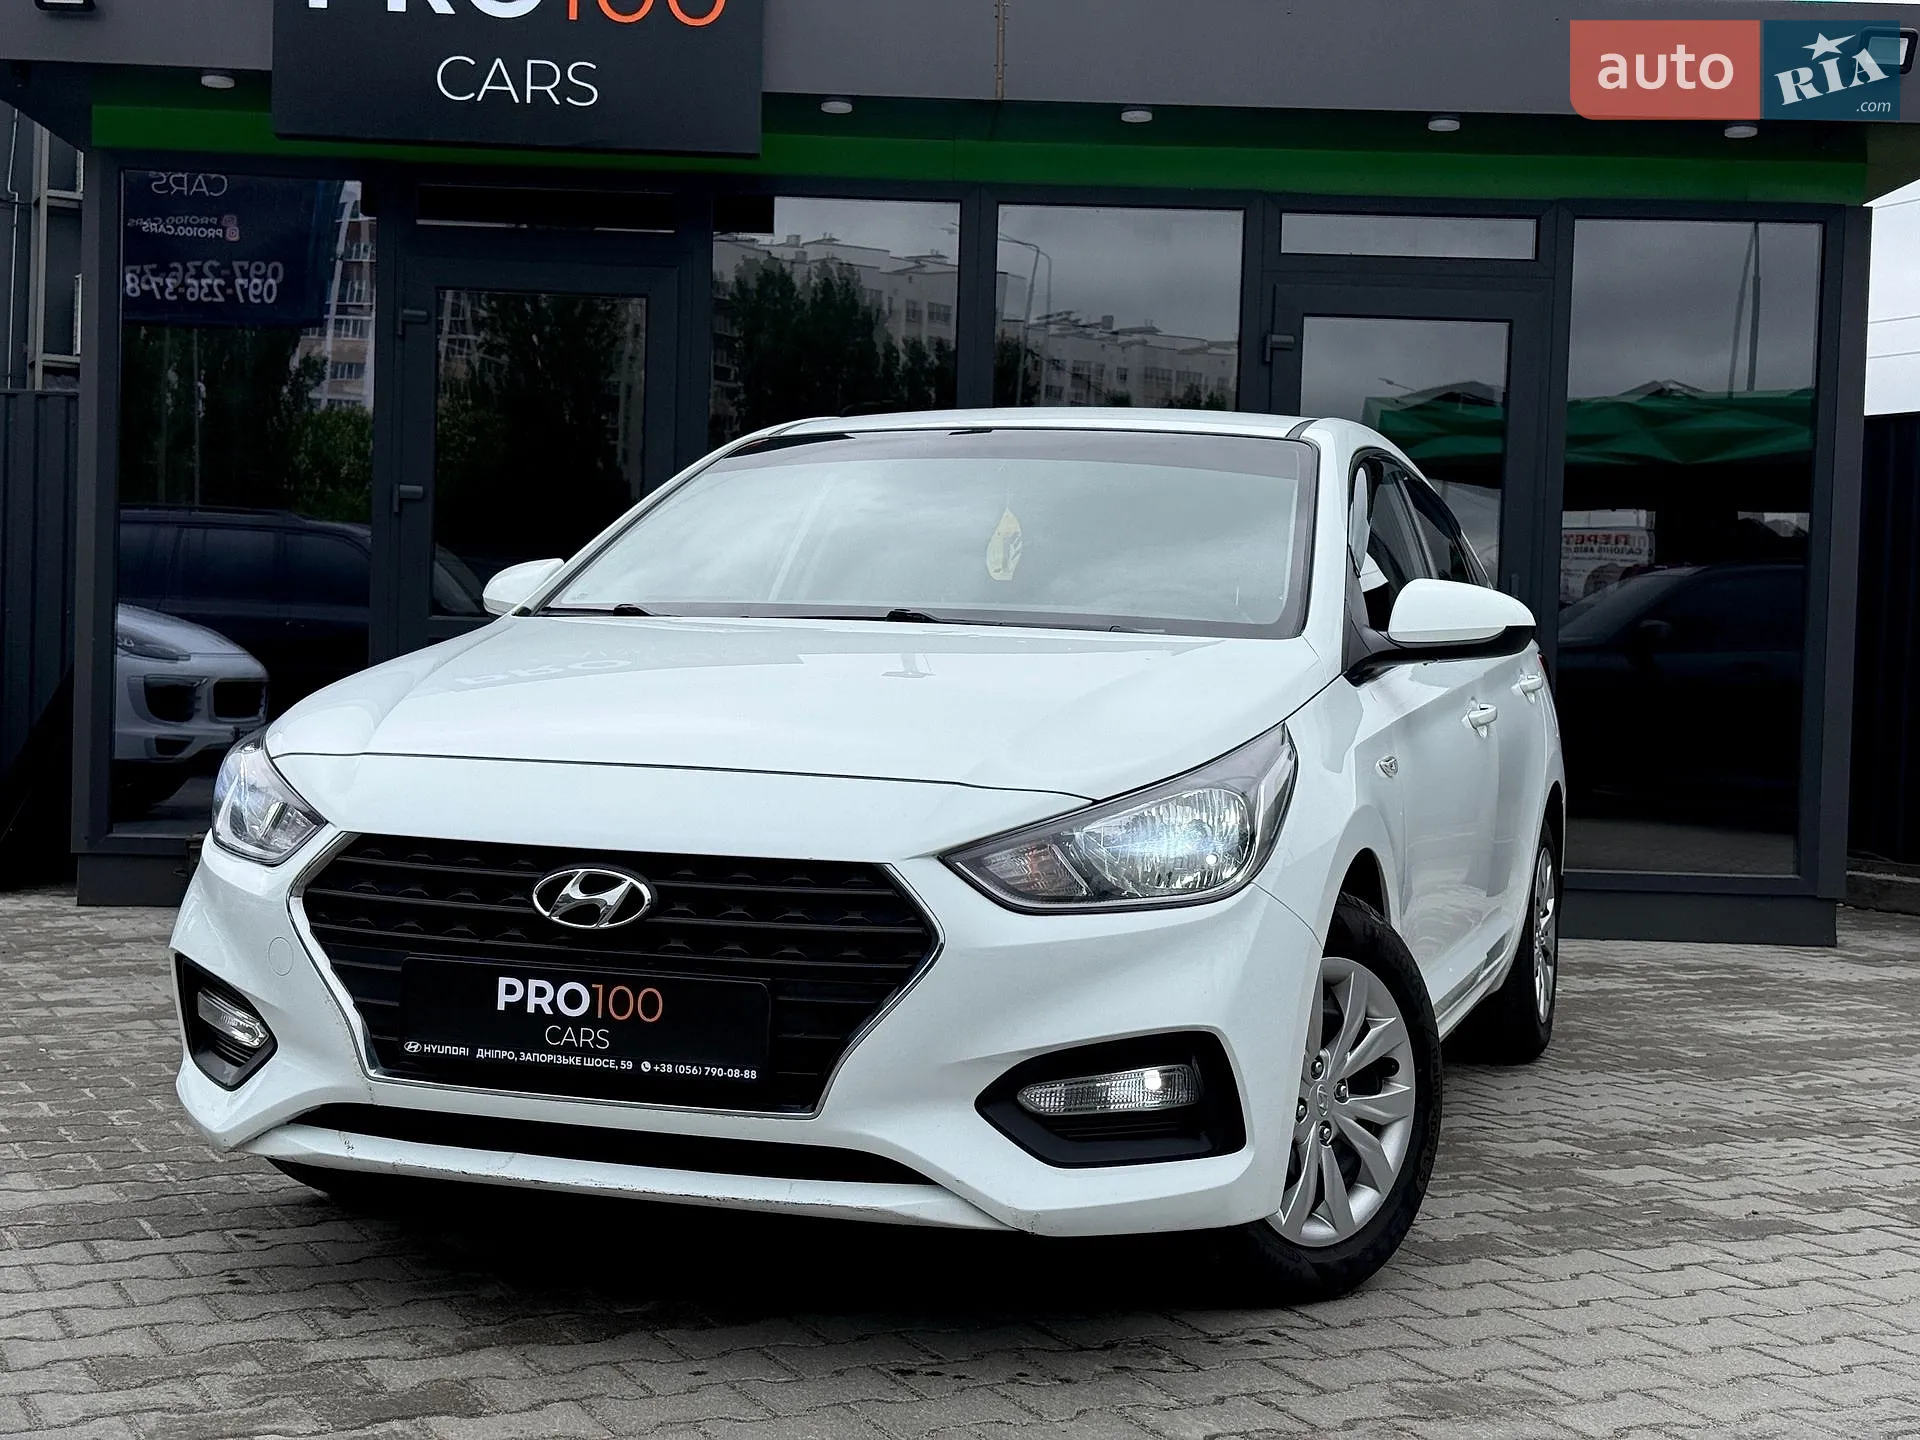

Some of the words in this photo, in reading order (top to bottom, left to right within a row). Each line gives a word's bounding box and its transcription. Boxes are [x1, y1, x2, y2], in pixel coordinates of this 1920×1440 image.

[436, 55, 599, 107] CARS
[497, 976, 664, 1023] PRO100
[545, 1025, 610, 1050] CARS
[423, 1044, 469, 1057] HYUNDAI
[476, 1048, 518, 1062] ДНІПРО,
[519, 1051, 582, 1066] ЗАПОРІЗЬКЕ
[583, 1057, 618, 1070] ШОСЕ,
[620, 1060, 633, 1070] 59
[653, 1063, 673, 1074] +38
[675, 1064, 702, 1076] (056)
[704, 1066, 757, 1080] 790-08-88
